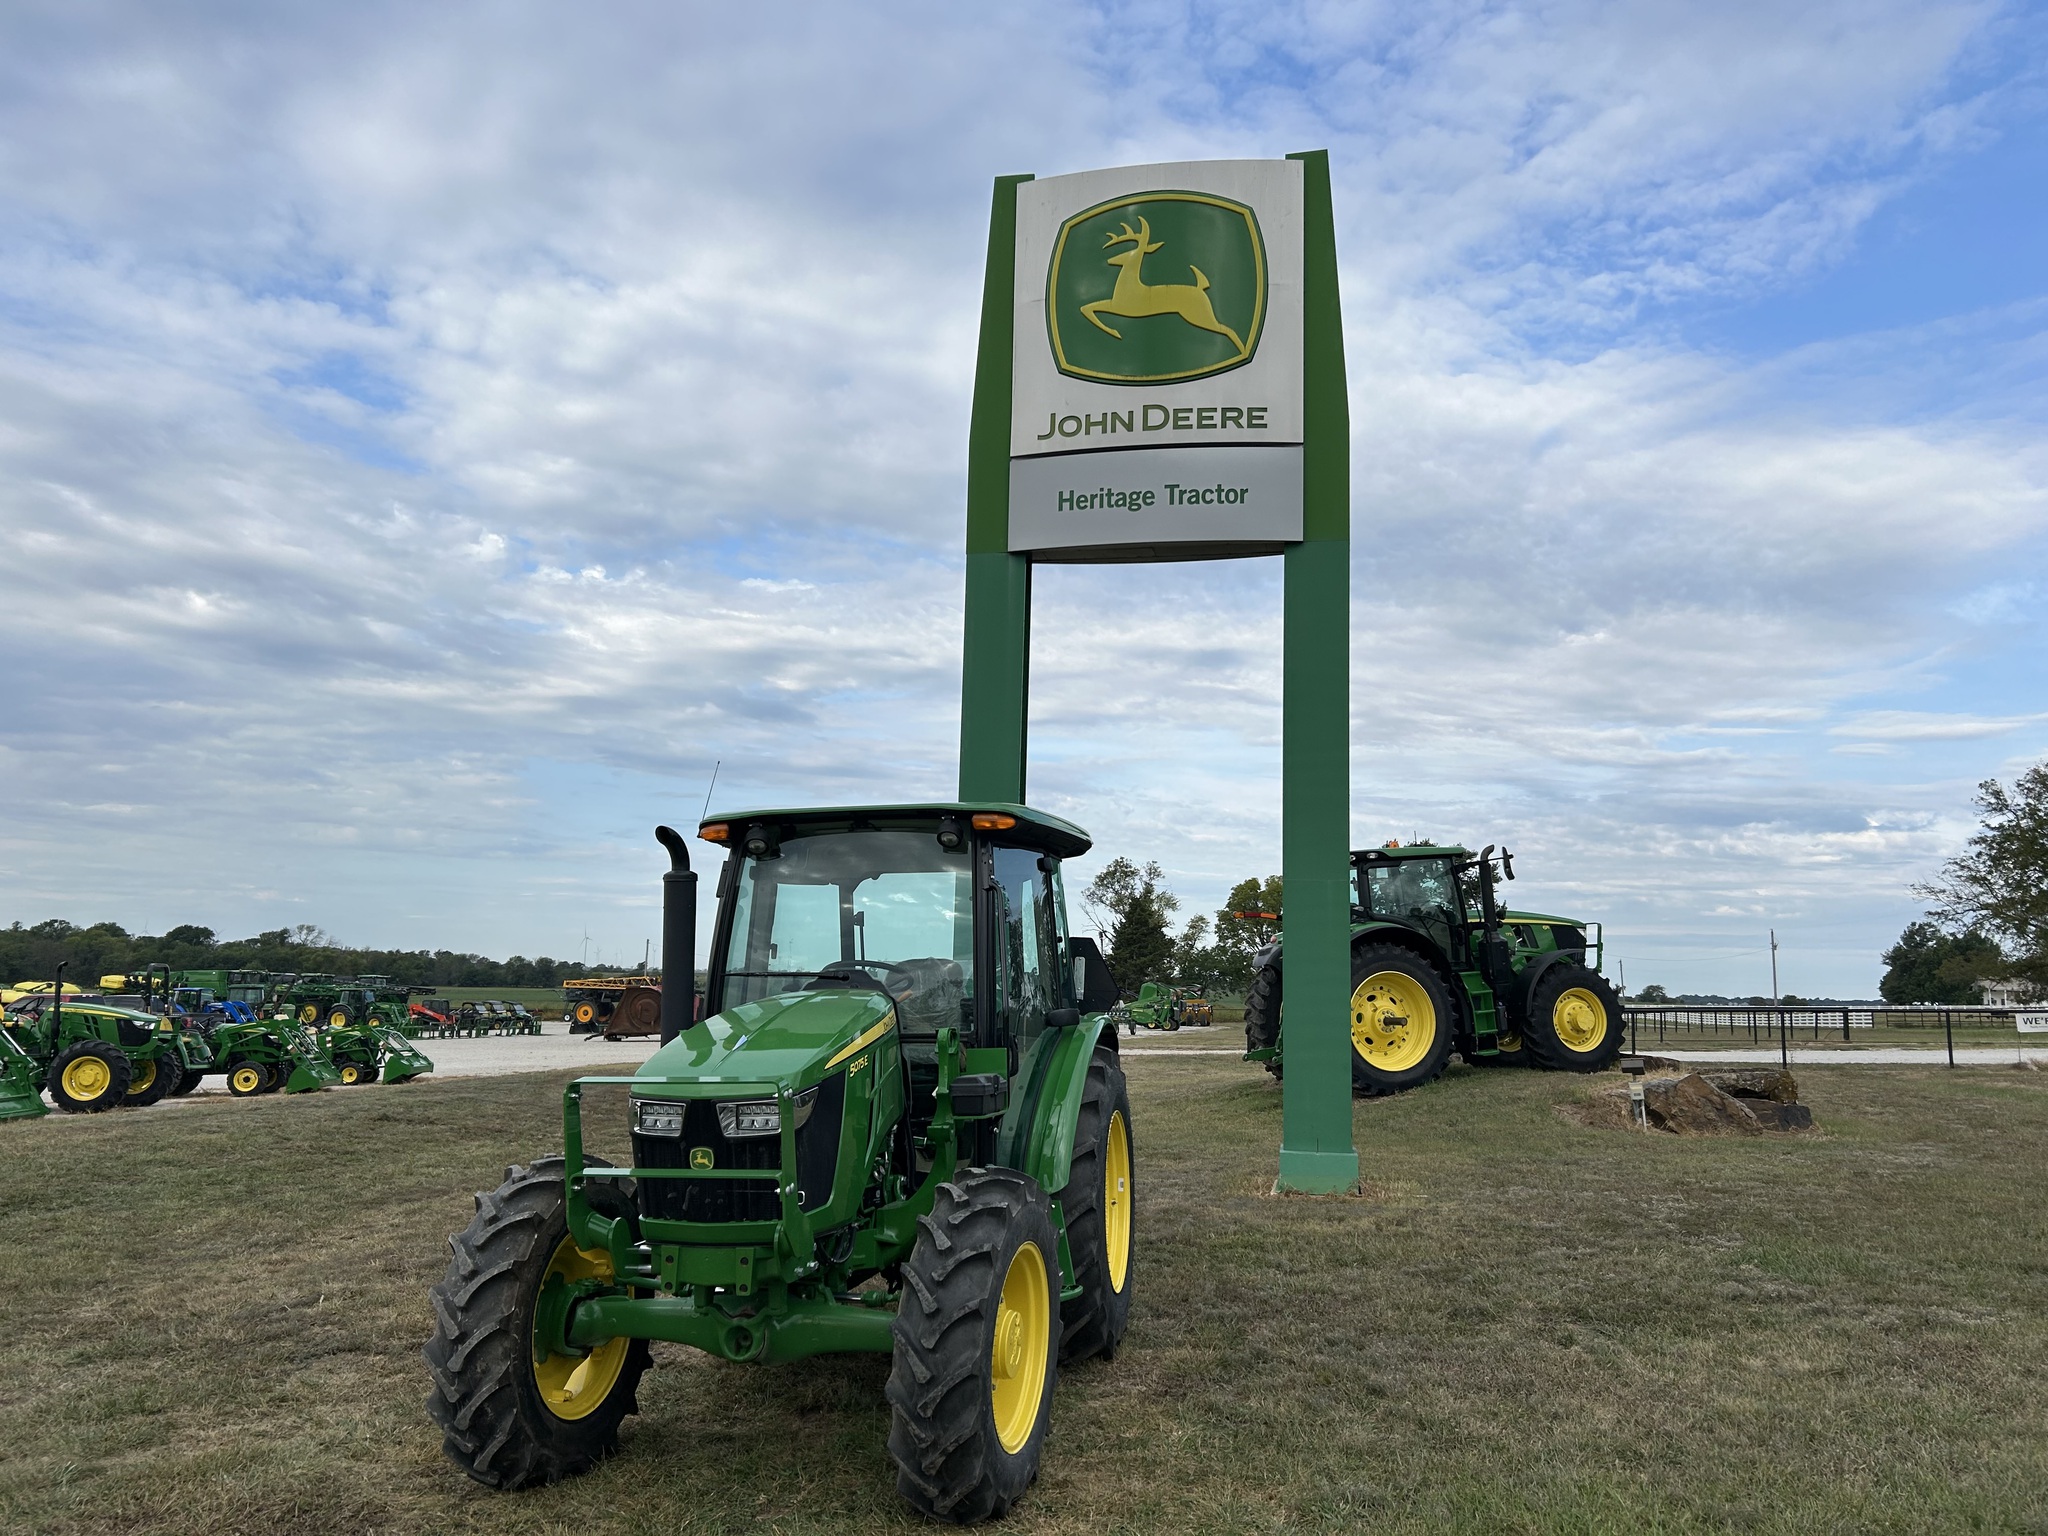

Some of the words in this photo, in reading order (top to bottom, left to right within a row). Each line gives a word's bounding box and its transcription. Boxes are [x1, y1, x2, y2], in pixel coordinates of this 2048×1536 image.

[1037, 410, 1134, 440] JOHN
[1142, 404, 1268, 432] DEERE
[1057, 487, 1155, 512] Heritage
[1164, 483, 1249, 505] Tractor
[849, 1054, 869, 1078] 5075E
